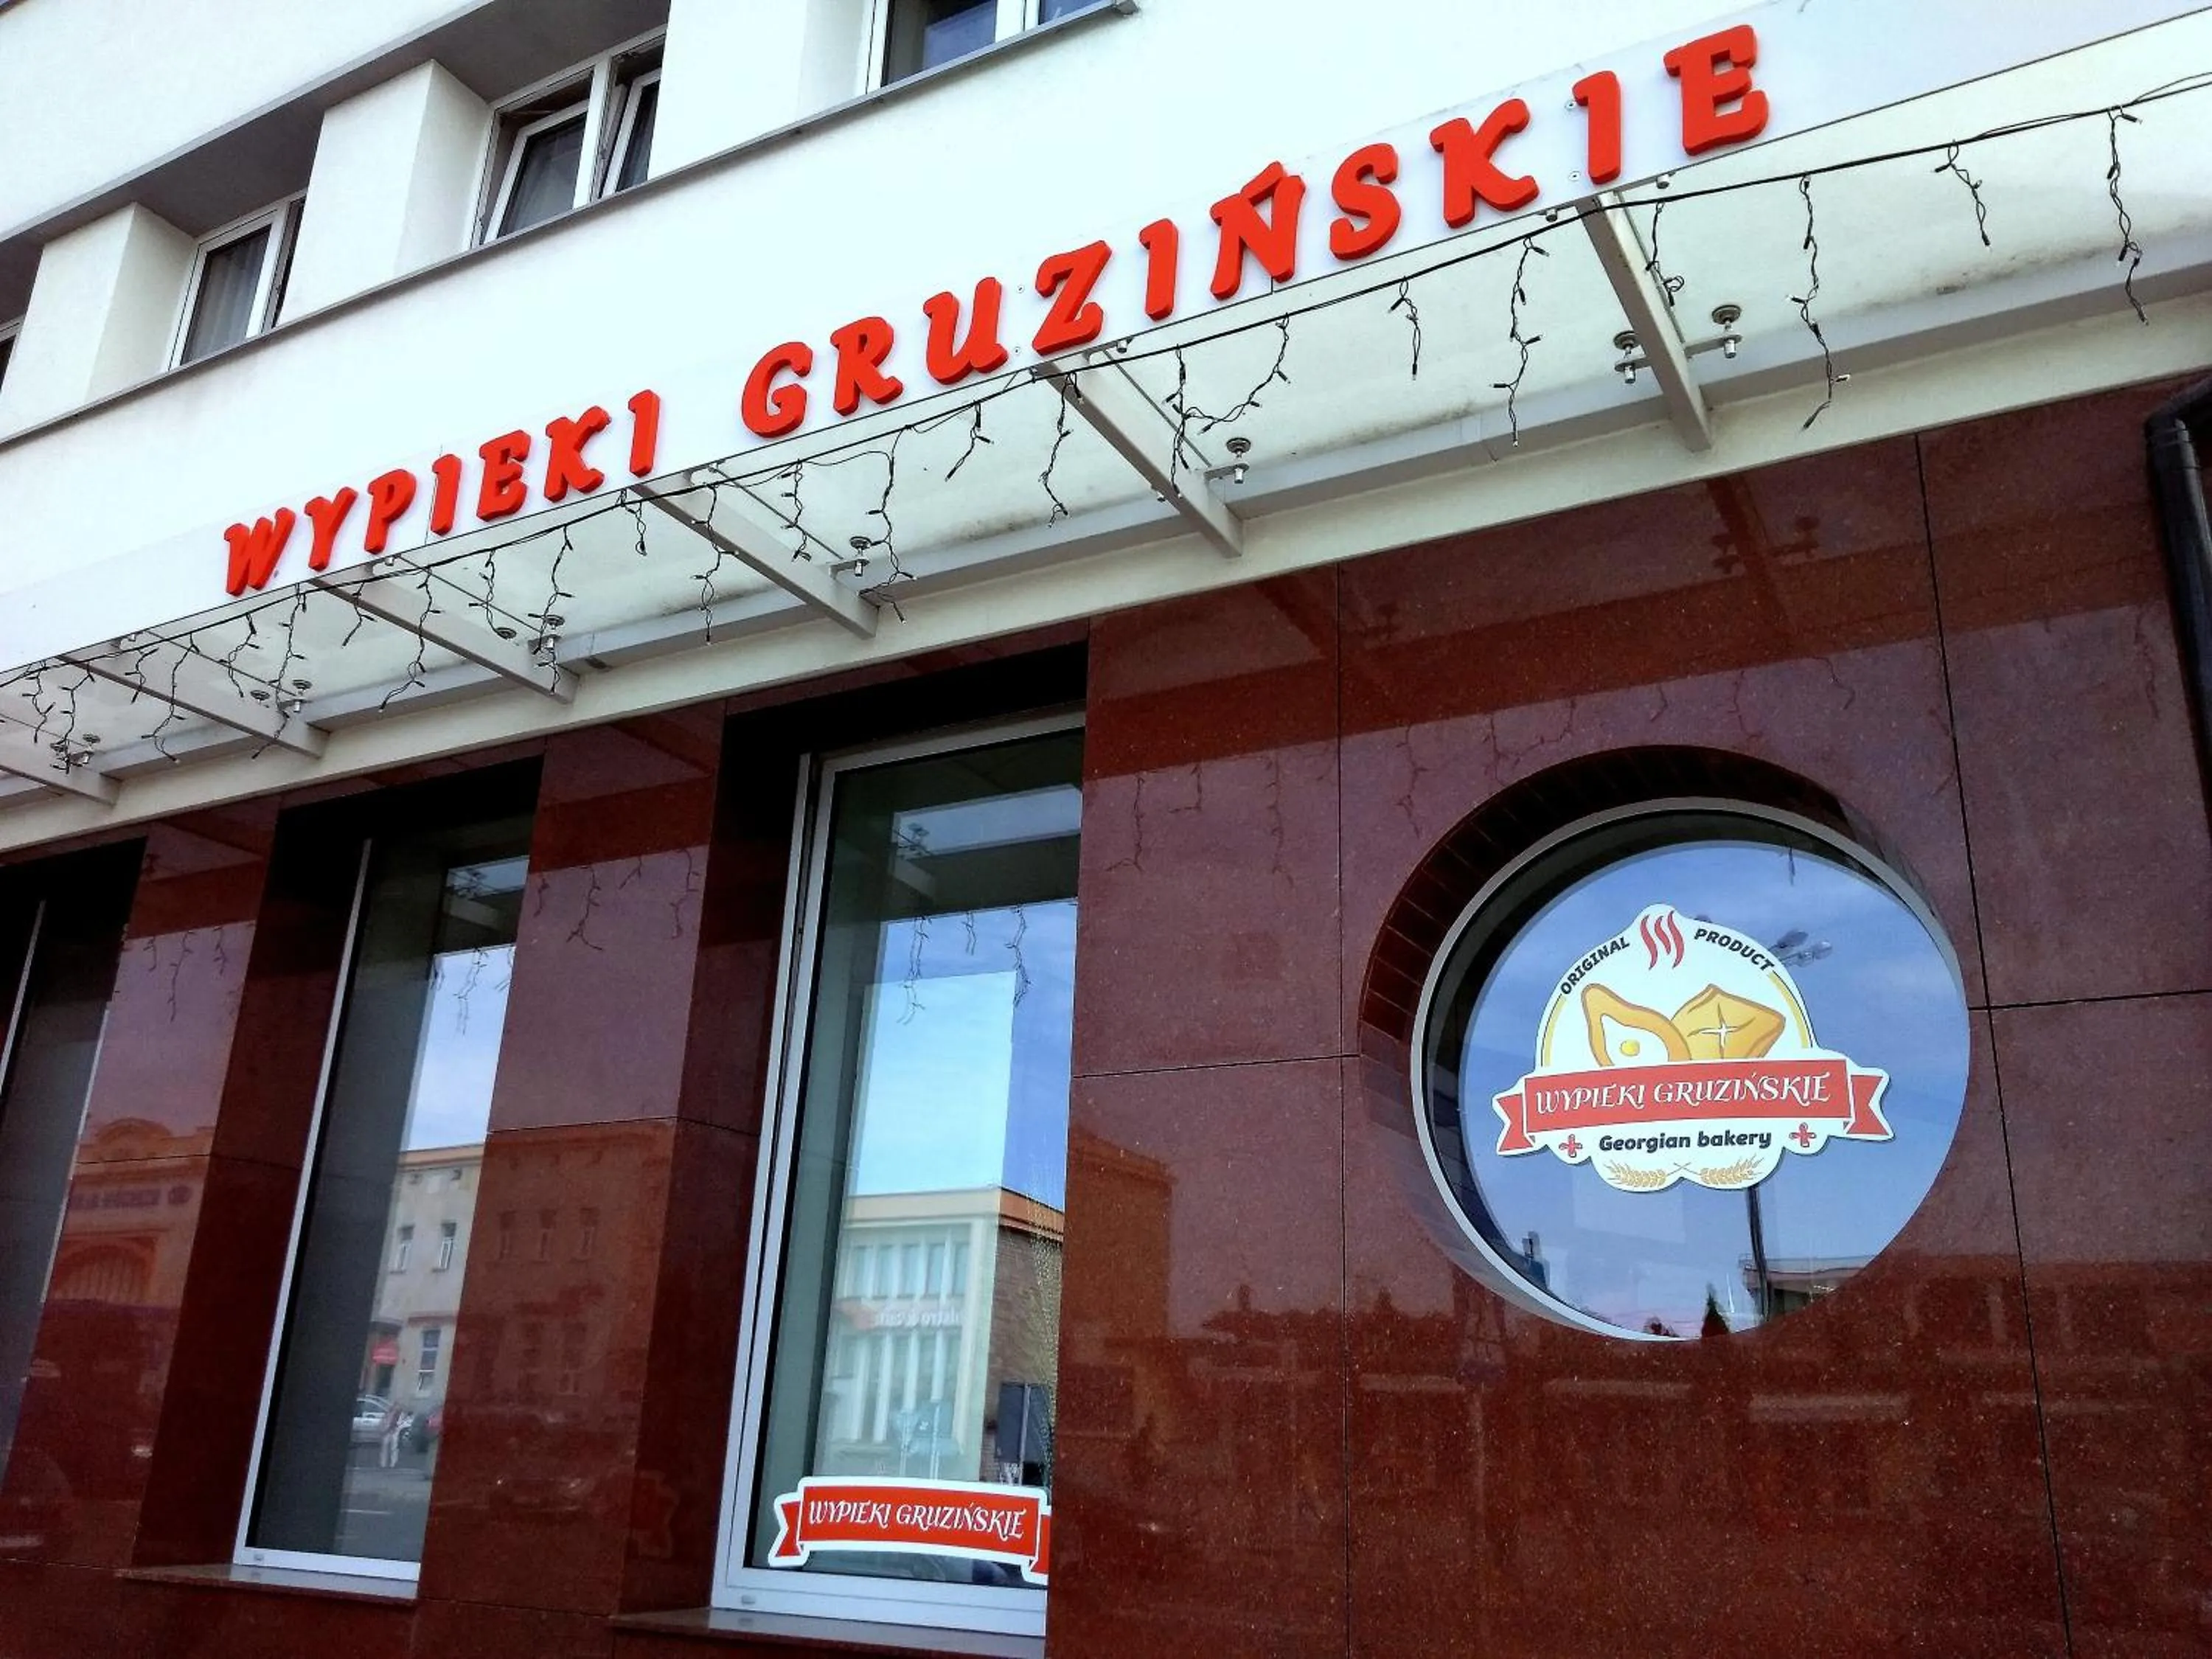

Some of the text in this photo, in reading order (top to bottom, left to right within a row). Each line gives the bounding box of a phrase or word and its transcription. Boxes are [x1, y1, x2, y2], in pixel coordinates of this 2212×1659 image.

[223, 24, 1770, 597] WYPIEKI GRUZIŃSKIE
[1560, 928, 1775, 995] ORIGINAL PRODUCT
[1535, 1071, 1831, 1114] WYPIEKI GRUZIŃSKIE
[1599, 1130, 1773, 1153] Georgian bakery
[809, 1498, 1027, 1542] WYPIEKI GRUZIŃSKIE
